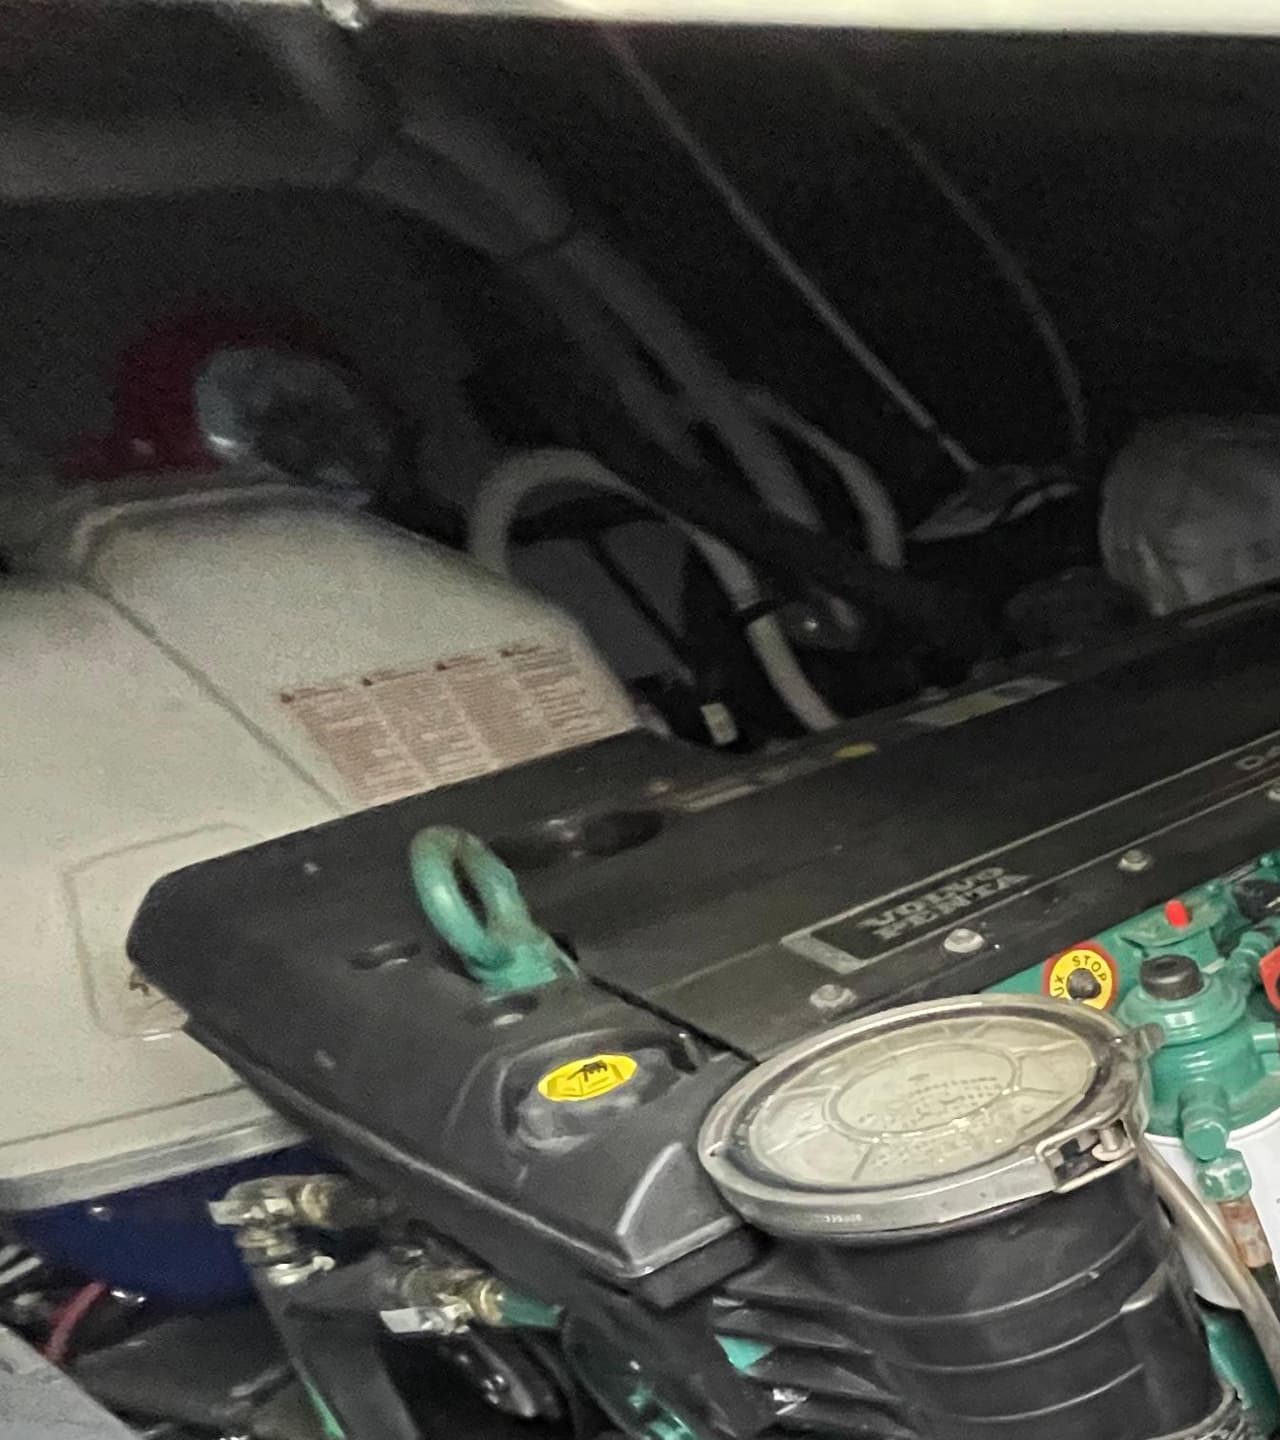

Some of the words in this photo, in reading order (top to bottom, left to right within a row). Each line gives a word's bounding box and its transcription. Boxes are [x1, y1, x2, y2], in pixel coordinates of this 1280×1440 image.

[856, 867, 1004, 928] VOLVO
[872, 874, 1032, 940] PENTA
[1071, 954, 1107, 982] STOP
